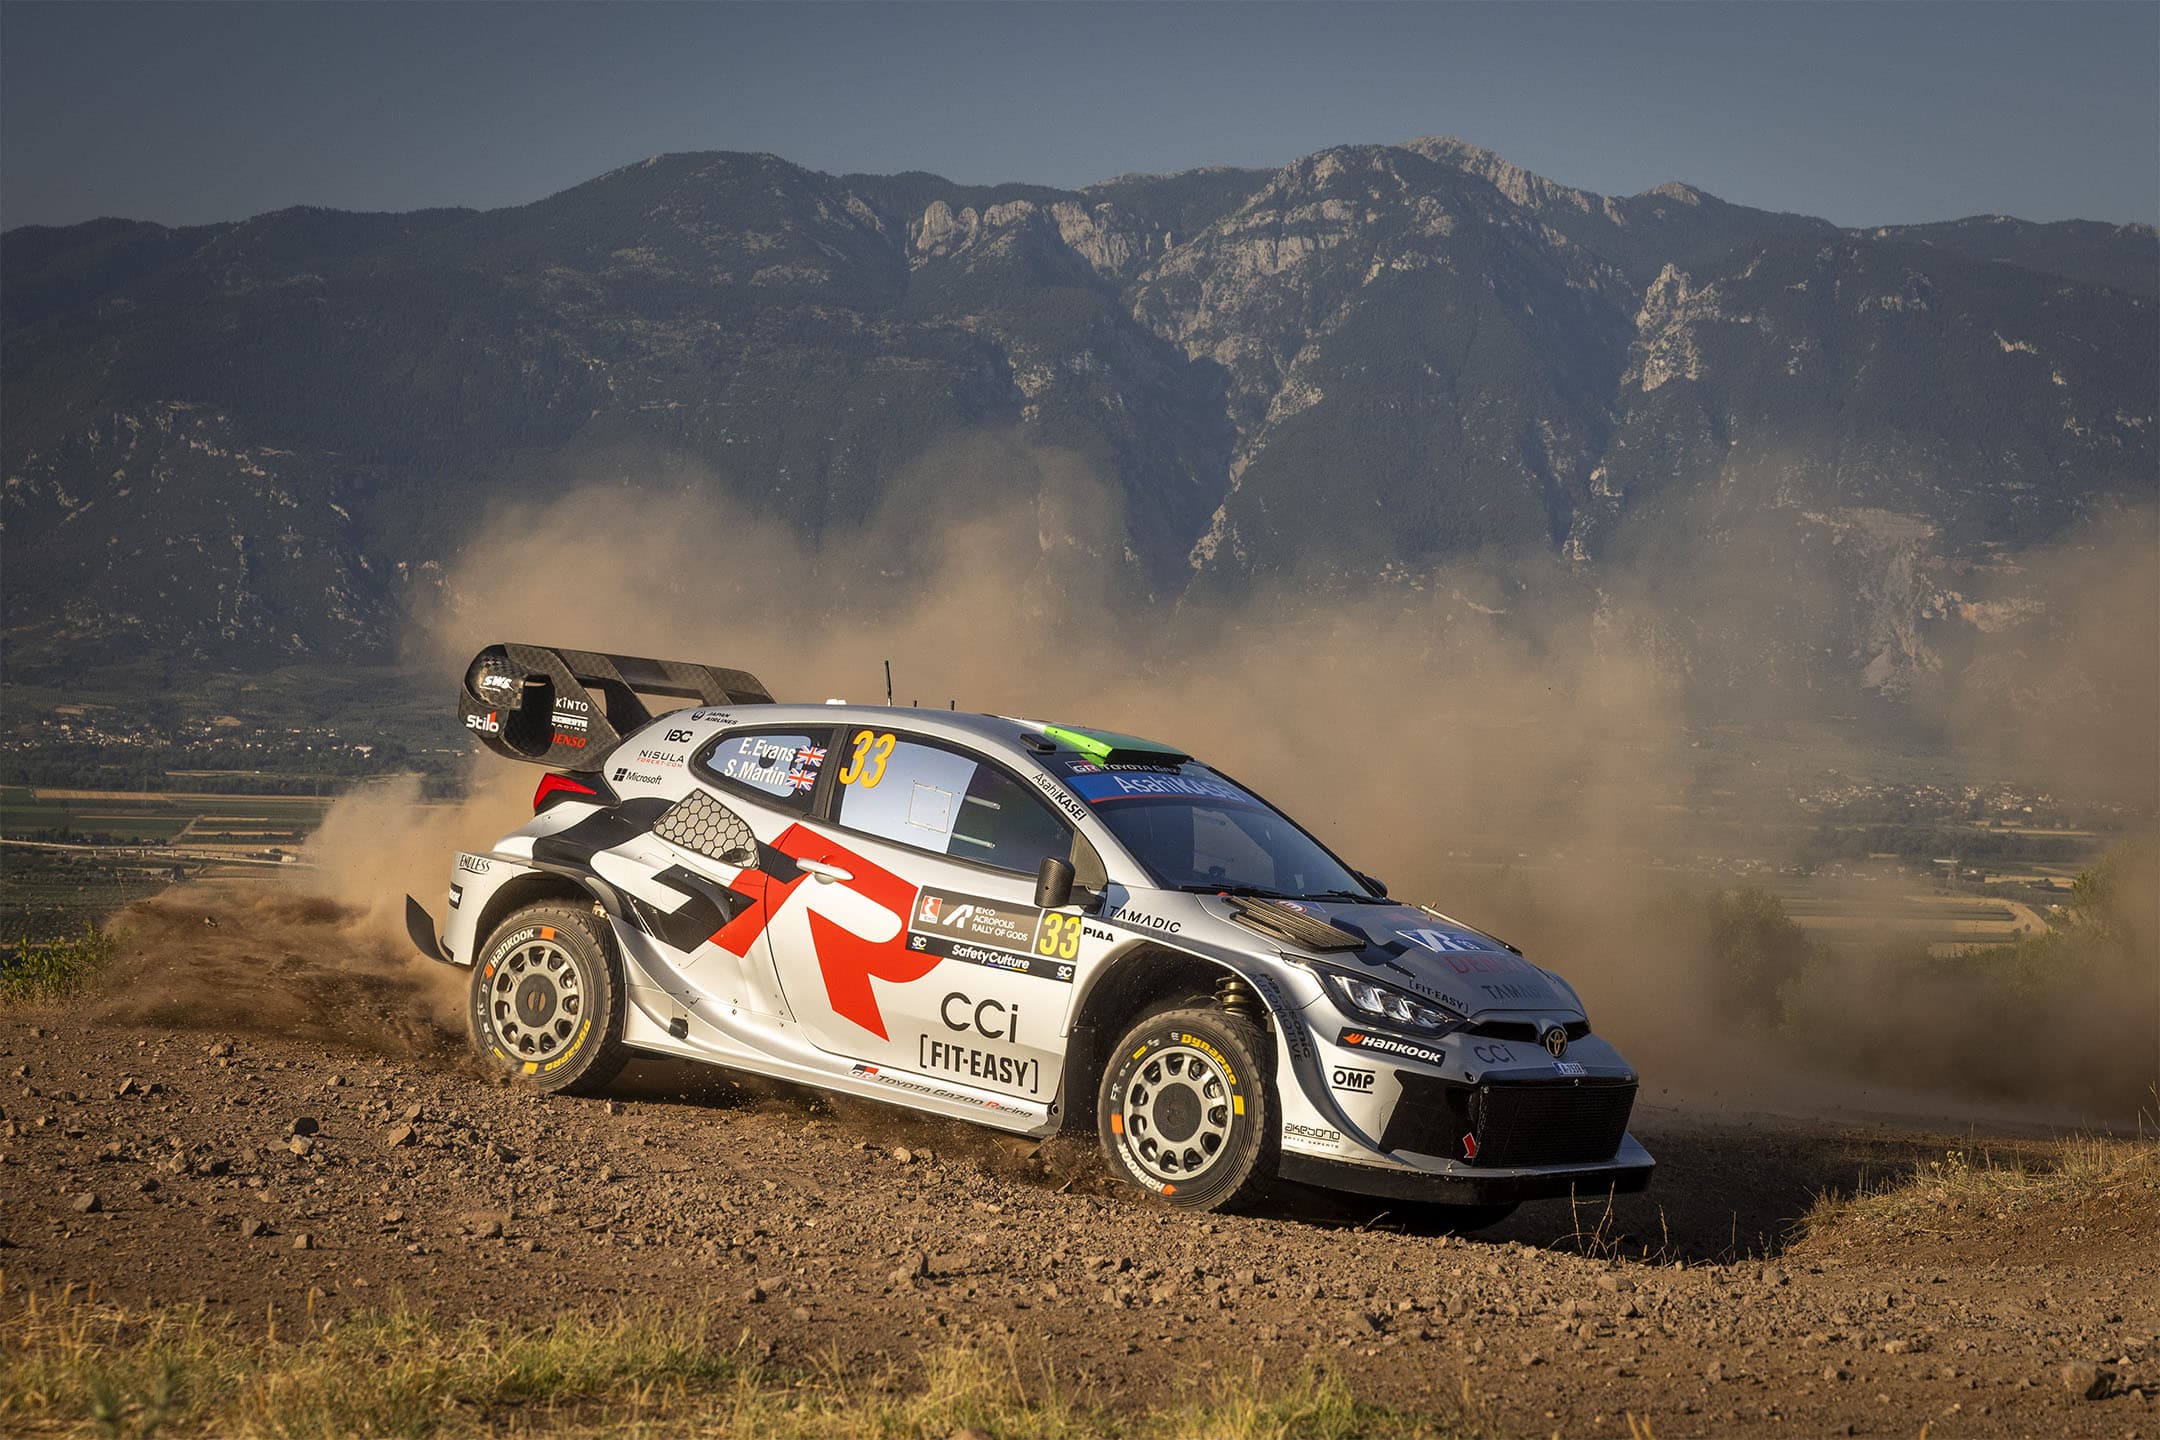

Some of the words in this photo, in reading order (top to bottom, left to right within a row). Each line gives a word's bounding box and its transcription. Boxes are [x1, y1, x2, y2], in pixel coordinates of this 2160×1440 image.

[466, 711, 499, 732] Stilo
[704, 717, 738, 725] AIRLINES
[639, 749, 685, 763] NISULA
[738, 737, 797, 762] E.Evans
[839, 730, 898, 789] 33
[1102, 764, 1150, 772] TOYOTA
[626, 771, 662, 785] Microsoft
[724, 759, 786, 786] S.Martin
[459, 854, 491, 875] ENDLESS
[975, 906, 996, 916] EKO
[1110, 906, 1182, 933] TAMADIC
[973, 916, 1015, 930] ACROPOLIS
[912, 936, 927, 948] SC
[971, 925, 994, 937] RALLY
[994, 929, 1006, 938] OF
[1006, 931, 1028, 942] GODS
[1039, 912, 1081, 959] 33
[1083, 926, 1114, 942] PIAA
[1057, 965, 1073, 978] SC
[1332, 1070, 1375, 1090] OMP
[878, 1075, 932, 1093] TOYOTA
[933, 1089, 984, 1106] GAZOO
[984, 1101, 1033, 1118] Racing
[1284, 1122, 1341, 1141] akebono
